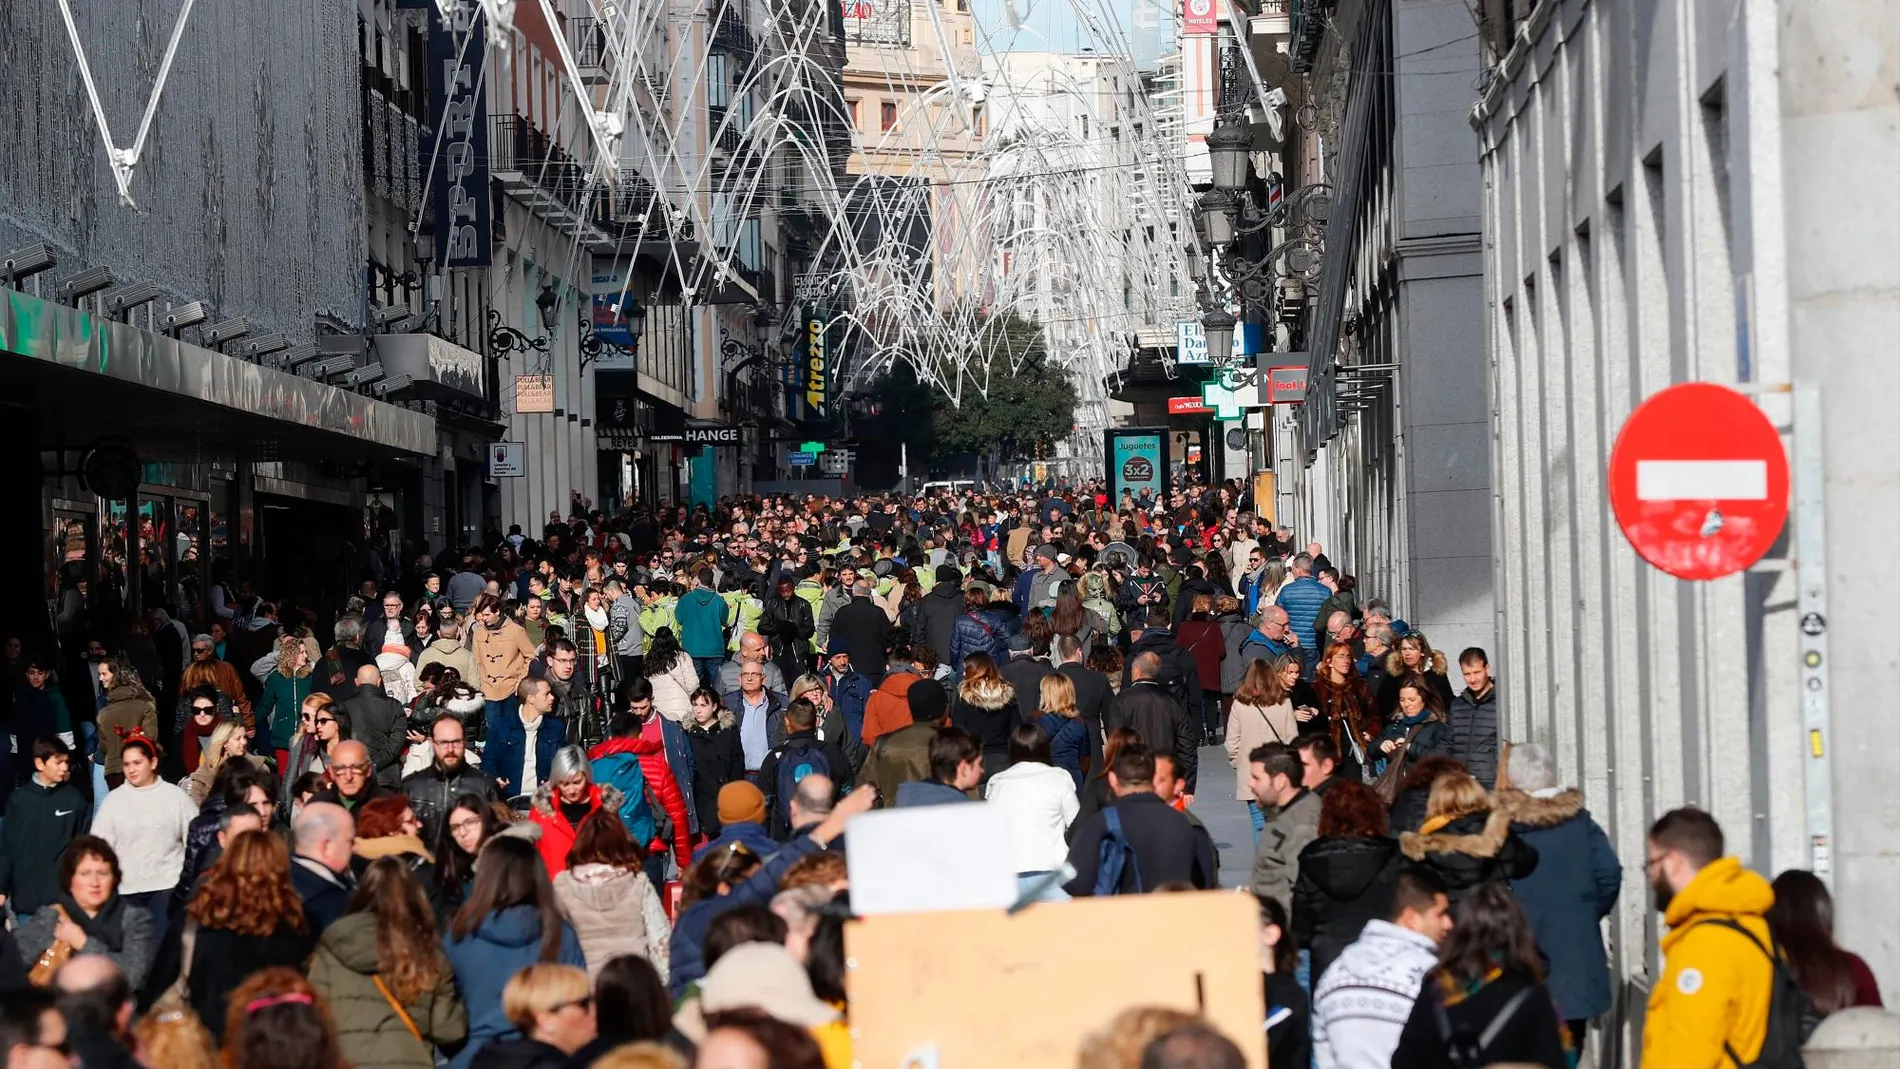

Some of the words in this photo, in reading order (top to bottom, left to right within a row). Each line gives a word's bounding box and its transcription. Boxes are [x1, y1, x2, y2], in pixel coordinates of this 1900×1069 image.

[443, 58, 478, 260] SPORT
[1184, 324, 1198, 336] El
[807, 319, 825, 418] Atrezzo
[685, 429, 738, 442] HANGE
[1119, 443, 1156, 451] Juguetes
[1125, 464, 1150, 476] 3x2
